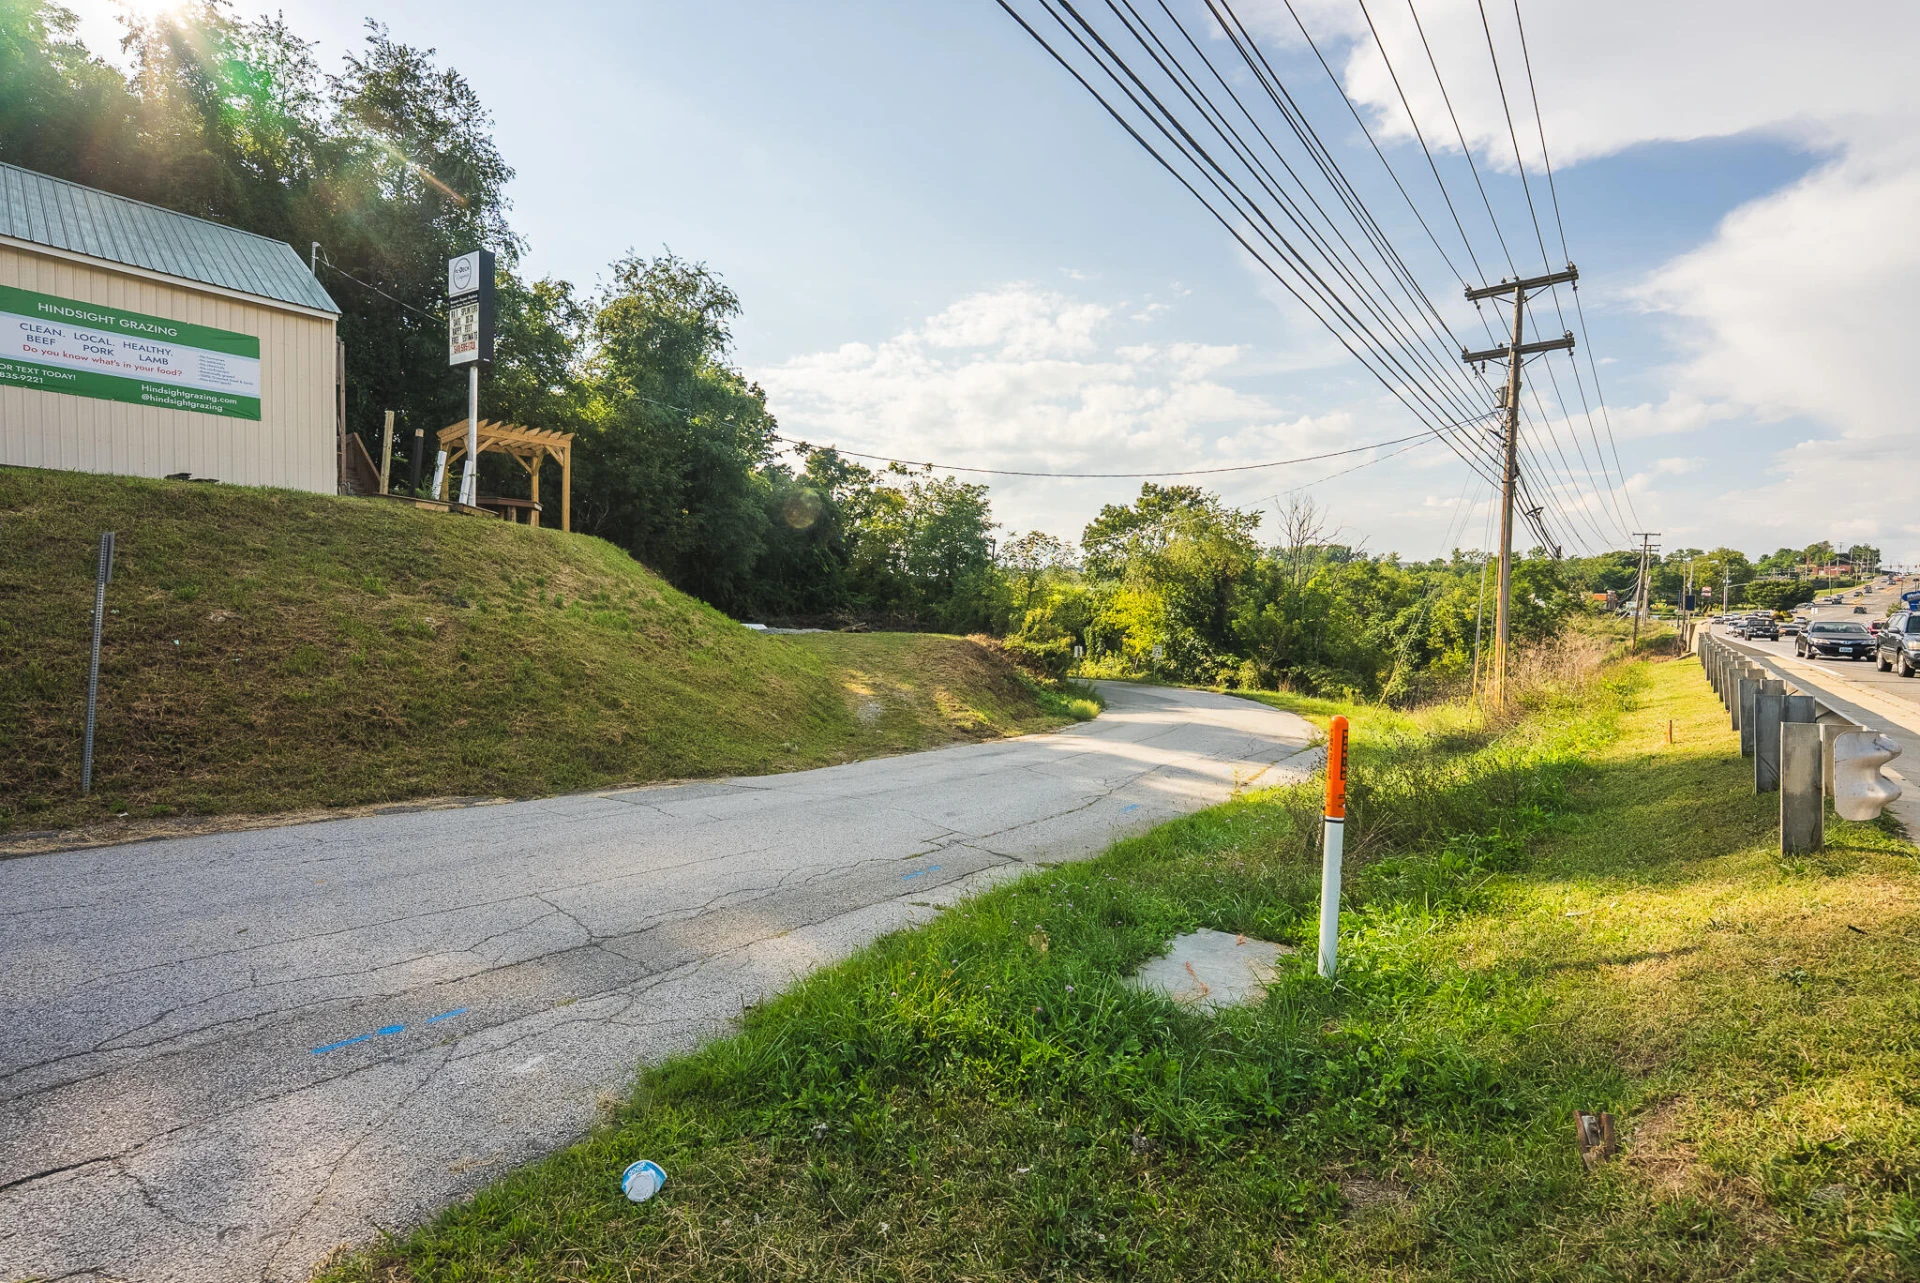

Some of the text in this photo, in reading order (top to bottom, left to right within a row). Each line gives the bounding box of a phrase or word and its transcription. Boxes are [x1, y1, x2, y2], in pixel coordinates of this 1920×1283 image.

[38, 302, 177, 336] HINDSIGHT GRAZING
[19, 322, 173, 356] CLEAN. LOCAL. HEALTHY.
[26, 334, 169, 365] BEEF PORK LAMB
[16, 365, 39, 374] TEXT
[42, 369, 76, 381] TODAY!
[22, 344, 38, 353] Do
[63, 350, 89, 361] know
[92, 356, 120, 367] what's
[135, 364, 154, 372] your
[157, 366, 182, 377] food?
[0, 371, 43, 383] 835-9221
[141, 384, 238, 404] Hindsightgrazing.com
[141, 393, 223, 412] @hindsightgrazing
